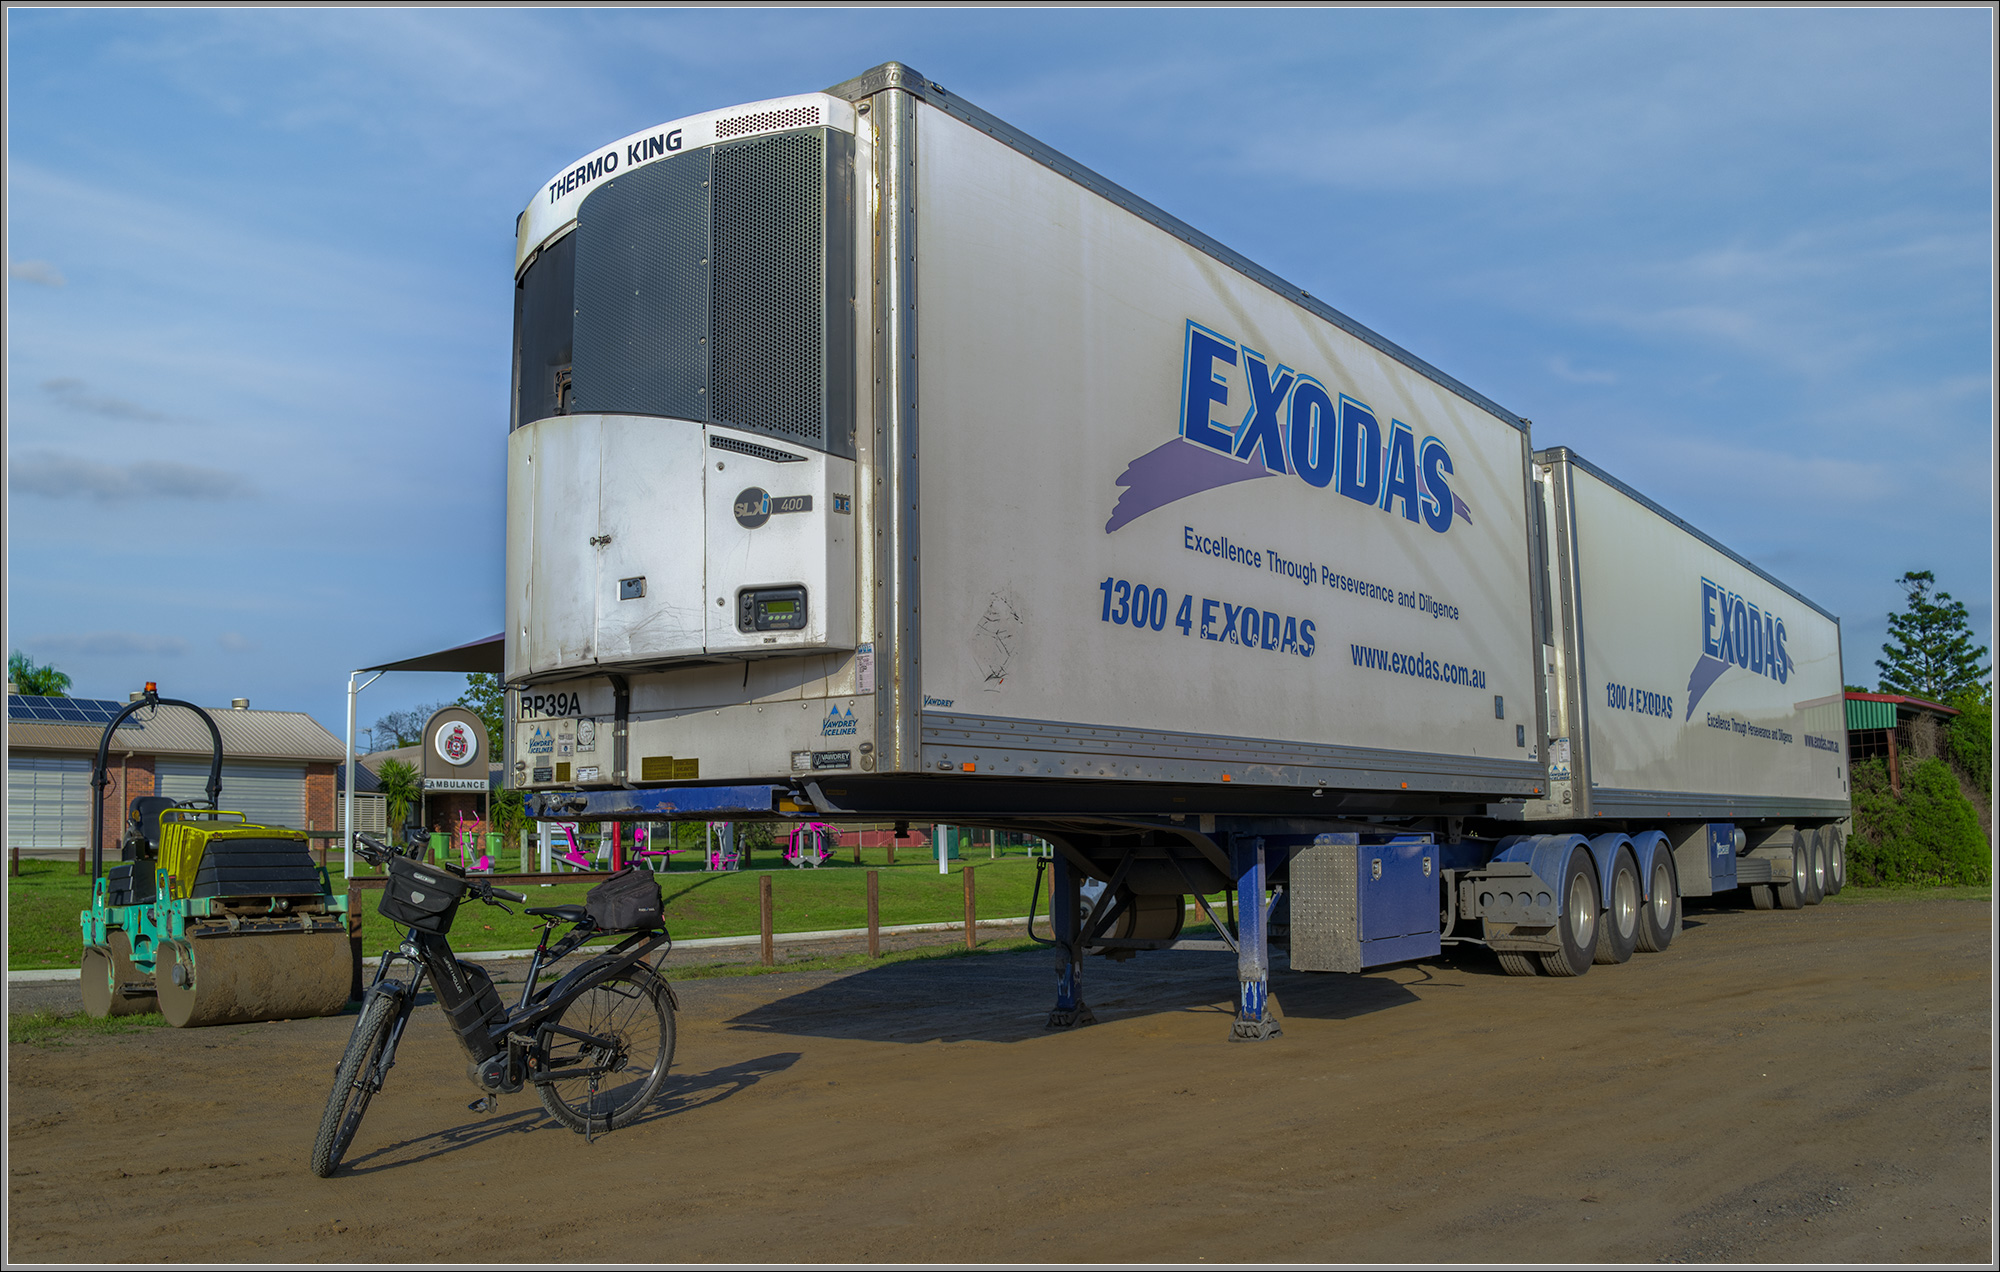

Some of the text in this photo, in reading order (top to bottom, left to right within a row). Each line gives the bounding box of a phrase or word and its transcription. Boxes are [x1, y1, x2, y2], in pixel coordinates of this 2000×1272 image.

[549, 129, 682, 204] THERMO KING
[1179, 318, 1454, 533] EXODAS
[781, 498, 803, 511] 400
[1184, 526, 1459, 621] Excellence Through Perseverance and Diligence
[1100, 577, 1317, 657] 1300 4 EXODAS
[1700, 576, 1788, 685] EXODAS
[1351, 643, 1486, 689] www.exodas.com.au
[521, 692, 582, 719] RP39A
[923, 695, 954, 707] VAWDREY
[1606, 682, 1673, 719] 1300 4 EXODAS
[823, 718, 858, 729] VAWDREY
[823, 728, 857, 736] ICELINER
[1707, 712, 1731, 732] Excellence
[1731, 717, 1747, 738] Through
[1747, 722, 1771, 740] Perseverance
[529, 738, 555, 748] VAWDREY
[821, 752, 850, 761] VAWDREY
[429, 780, 485, 789] AMBULANCE
